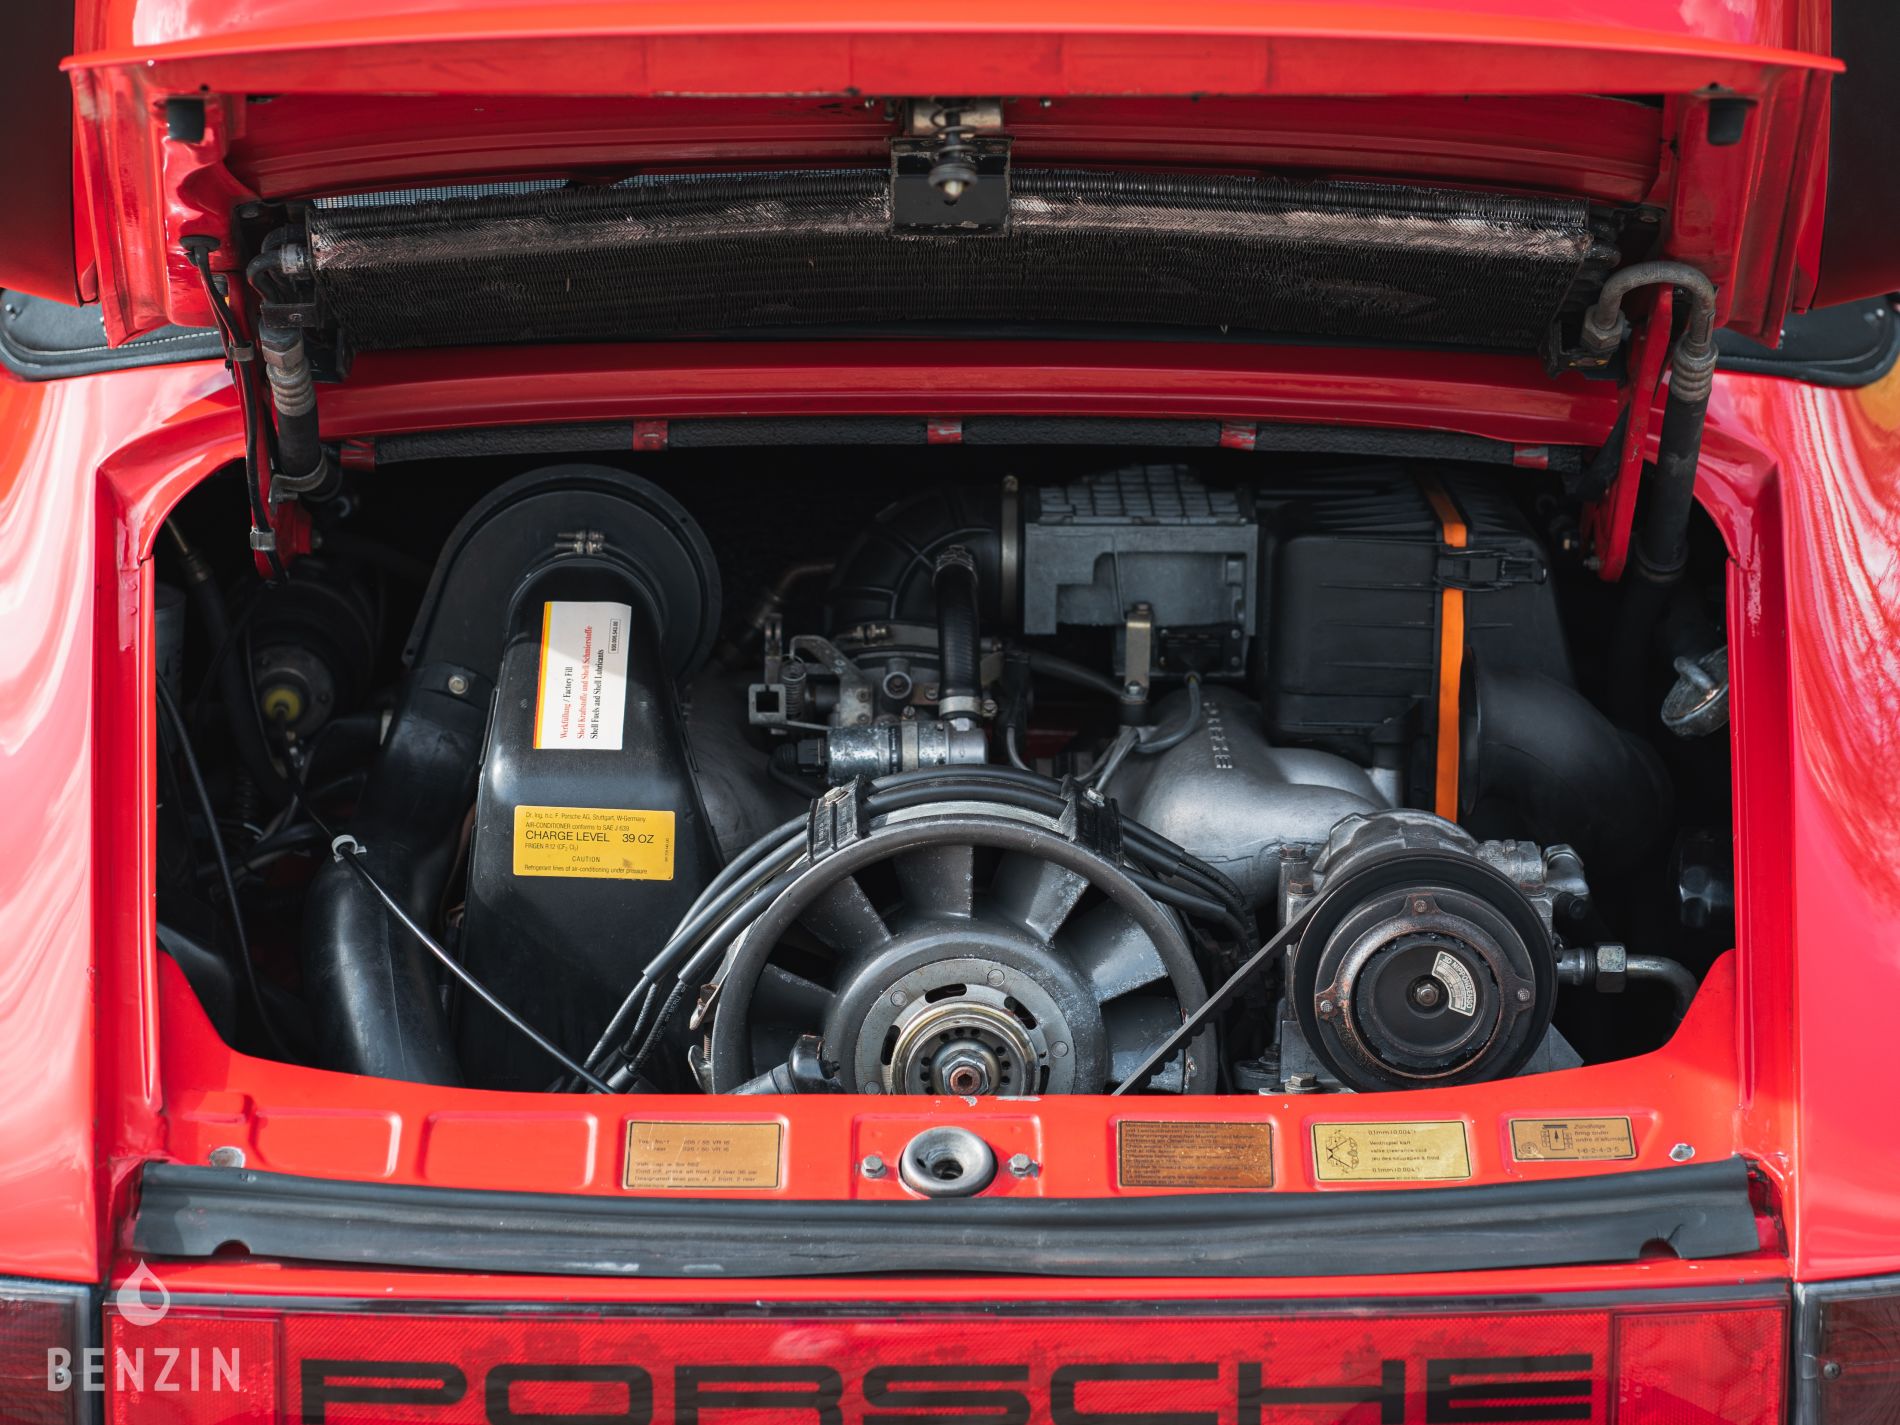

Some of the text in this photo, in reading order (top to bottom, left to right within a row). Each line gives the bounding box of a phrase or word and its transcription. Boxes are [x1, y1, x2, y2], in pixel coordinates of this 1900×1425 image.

[564, 666, 573, 677] Fill
[562, 678, 574, 698] Factory
[577, 625, 593, 739] Shell Kraftstoffe und Shell Schmierstoffe
[590, 649, 605, 739] Shell Fuels and Shell Lubricants
[616, 815, 646, 823] W-Germany
[525, 830, 654, 844] CHARGE LEVEL 39 OZ
[524, 864, 552, 872] Refrigerant
[300, 1353, 1593, 1425] PORSCHE
